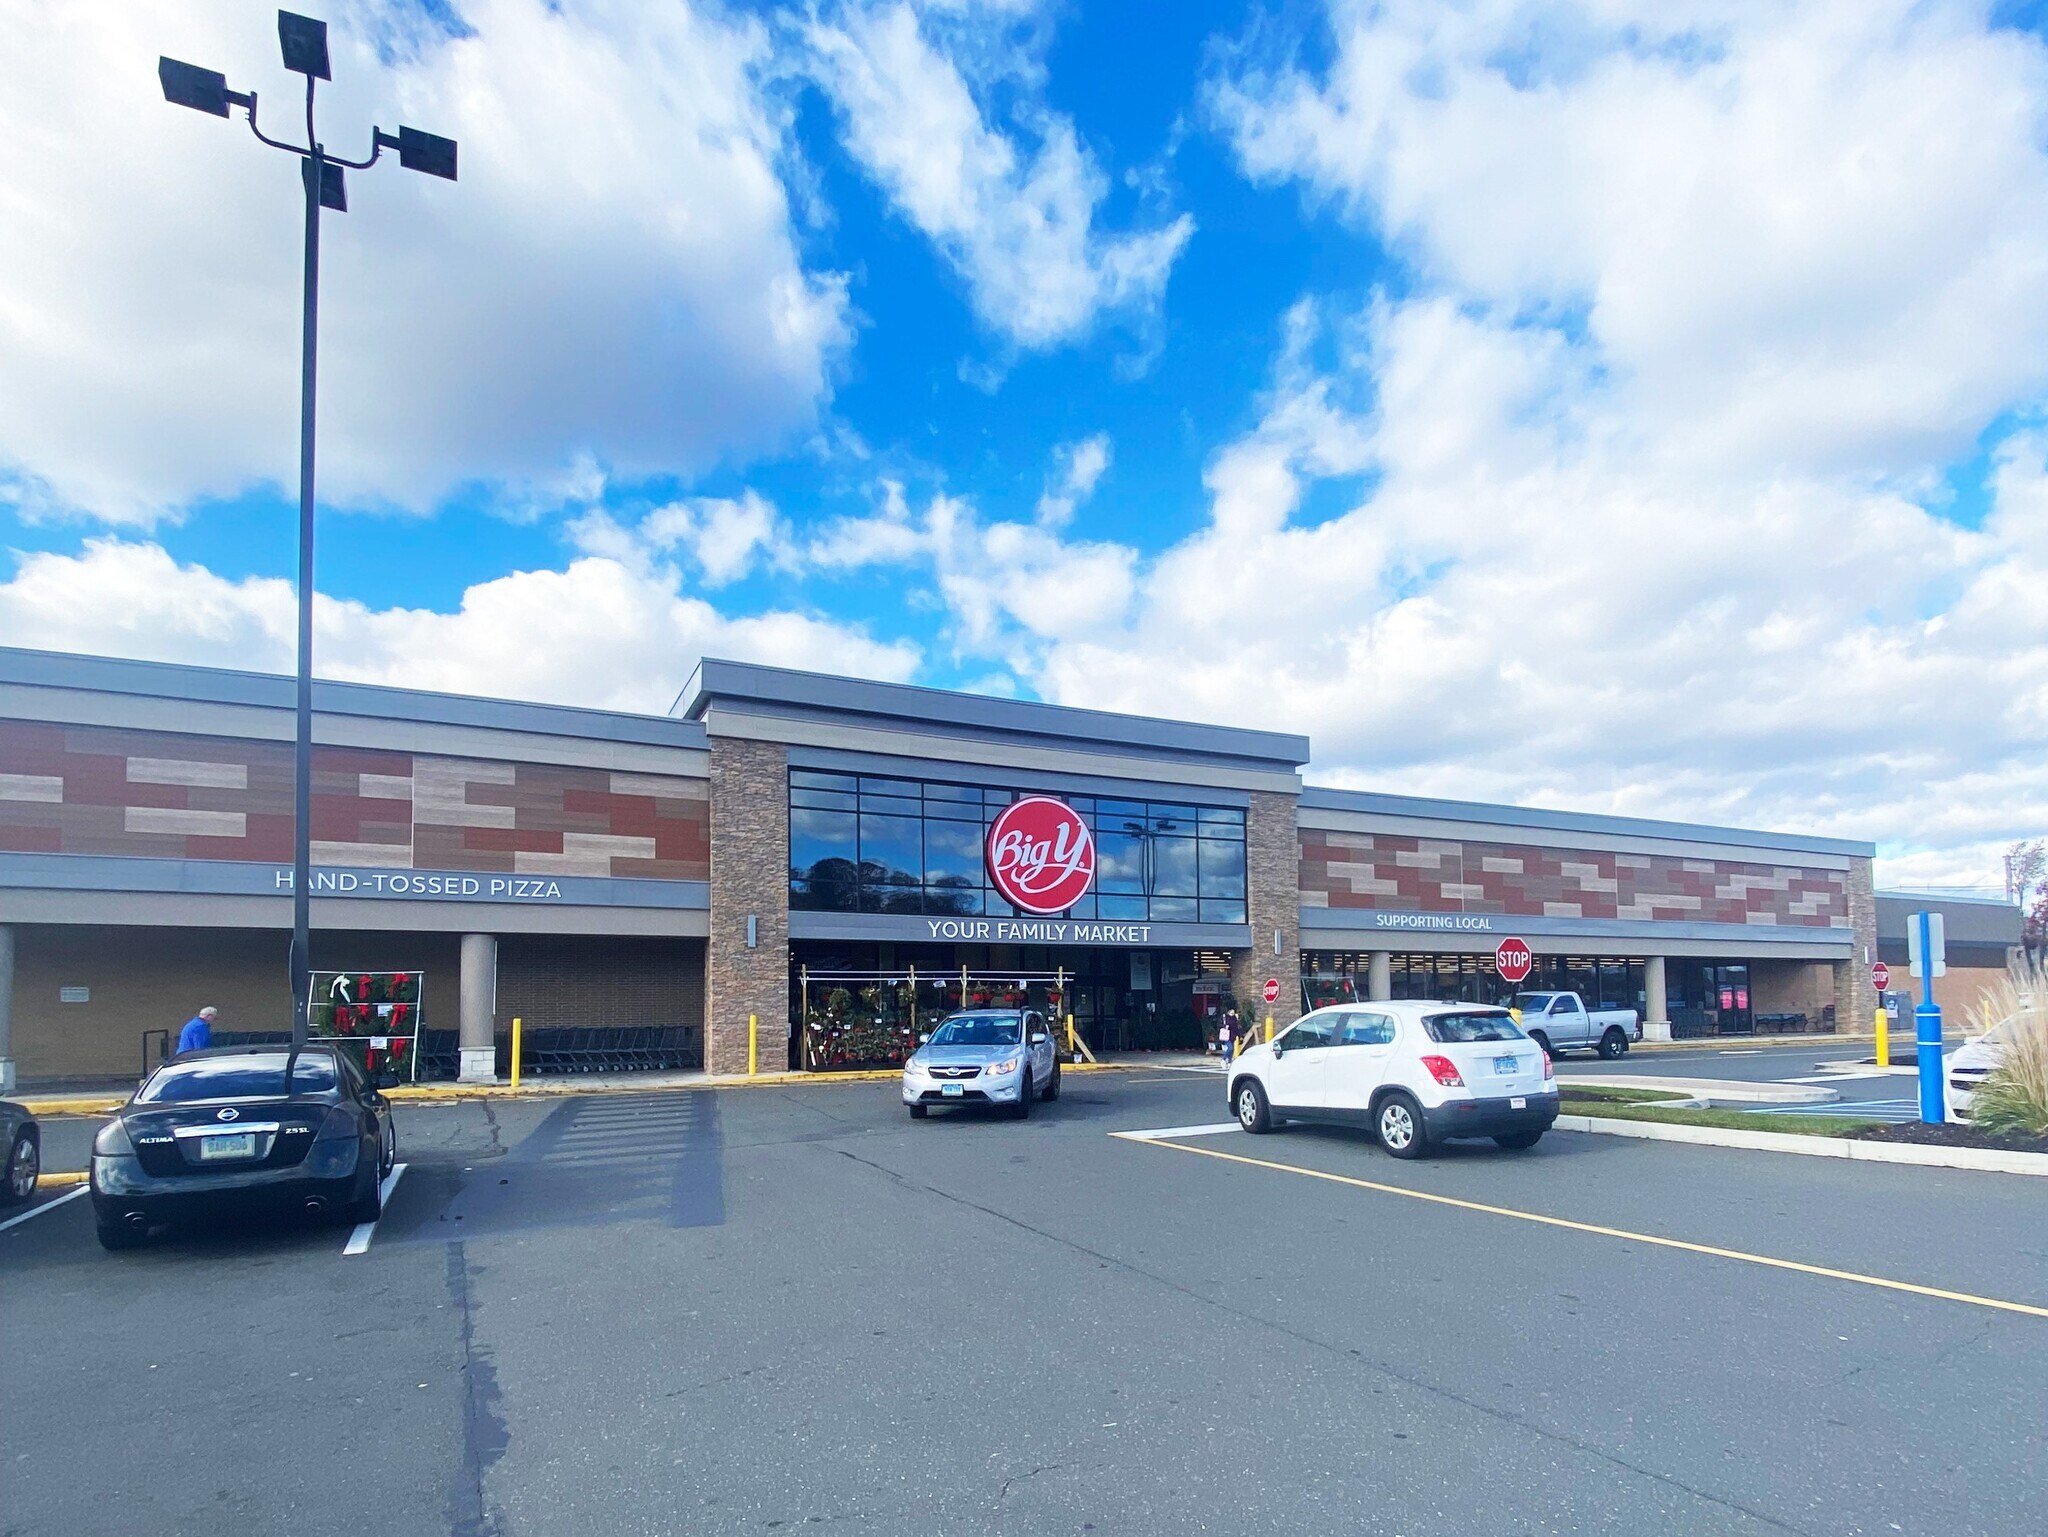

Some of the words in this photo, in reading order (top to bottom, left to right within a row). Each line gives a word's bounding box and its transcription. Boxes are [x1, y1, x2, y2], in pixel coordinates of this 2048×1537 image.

[275, 871, 480, 896] HND-TOSSED
[490, 879, 562, 898] PIZZA
[1376, 914, 1452, 929] SUPPORTING
[1455, 917, 1493, 930] LOCAL
[927, 920, 990, 939] YOUR
[997, 922, 1068, 941] FAMILY
[1074, 925, 1151, 942] MARKET
[1498, 951, 1529, 968] STOP
[1873, 971, 1888, 982] STOP
[1264, 986, 1279, 996] STOP
[139, 1136, 174, 1144] ALTIMA
